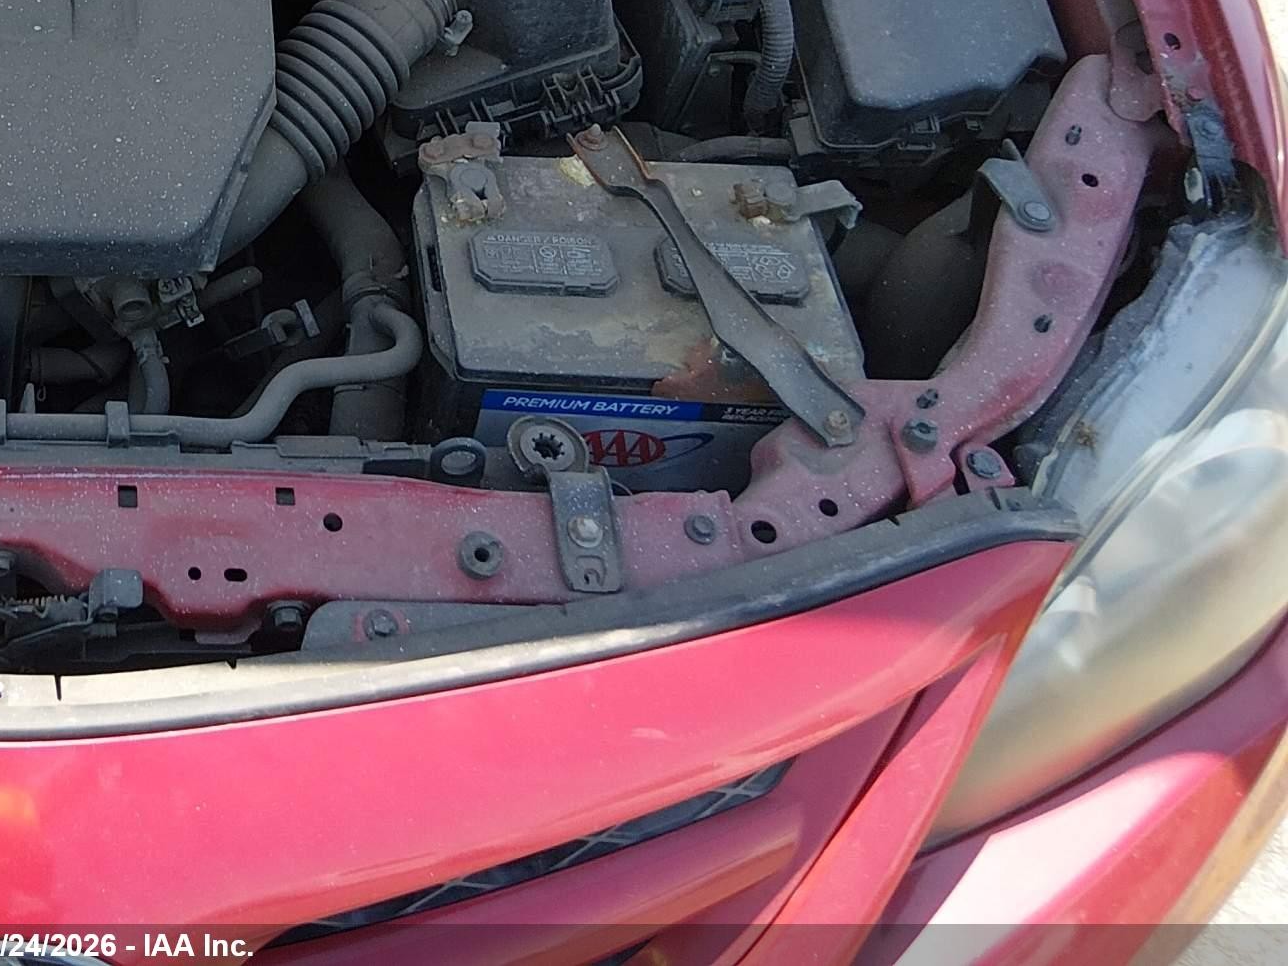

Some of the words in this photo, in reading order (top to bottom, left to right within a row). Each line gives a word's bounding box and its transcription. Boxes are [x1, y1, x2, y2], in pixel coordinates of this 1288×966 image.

[503, 396, 591, 412] PREMIUM
[592, 401, 679, 416] BATTERY
[735, 407, 767, 416] YEAR
[585, 429, 652, 467] AAA
